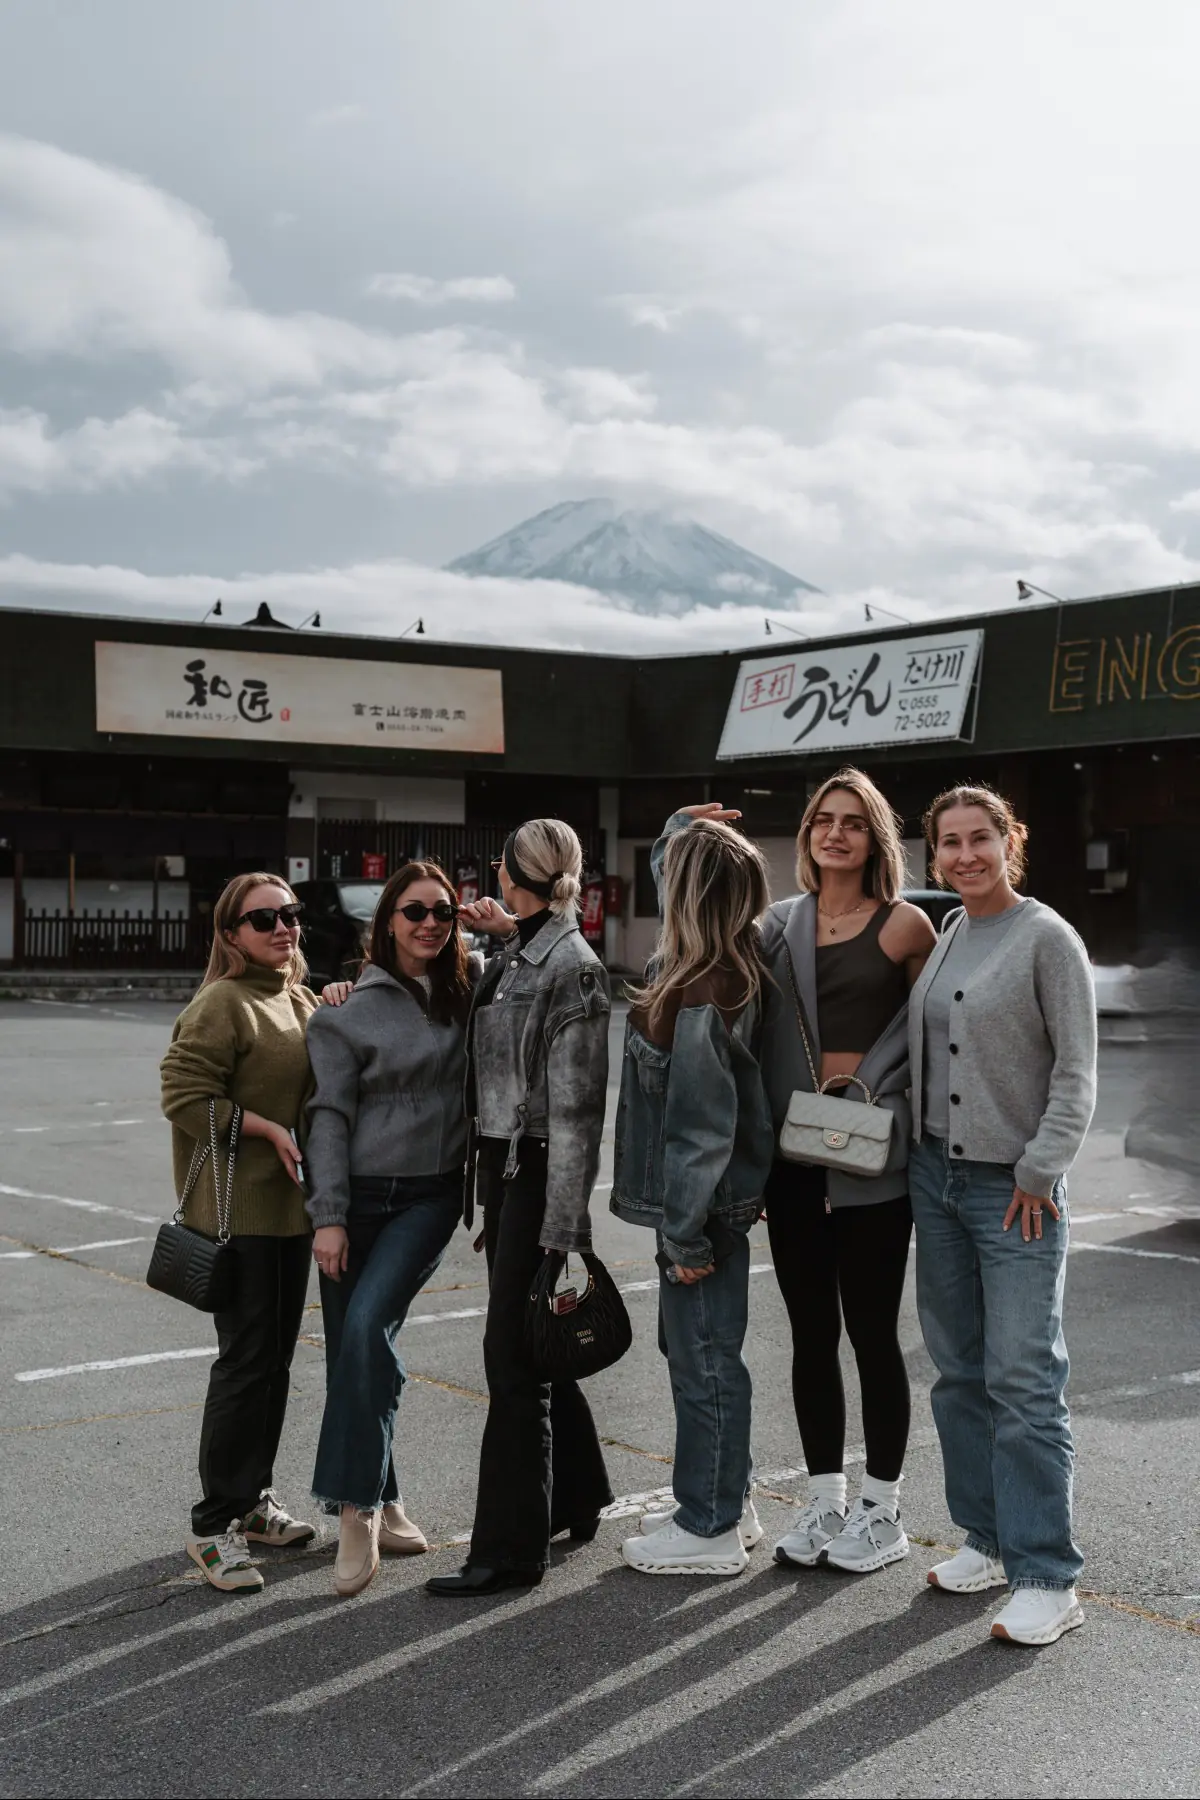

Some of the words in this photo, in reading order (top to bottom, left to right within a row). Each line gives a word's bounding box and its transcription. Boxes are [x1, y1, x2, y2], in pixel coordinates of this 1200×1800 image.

[904, 650, 965, 685] たけ川
[1049, 624, 1200, 712] ENG
[183, 658, 273, 723] 和匠
[747, 673, 788, 704] 手打
[783, 652, 892, 745] うどん
[910, 694, 939, 710] 0555
[894, 710, 951, 732] 72-5022
